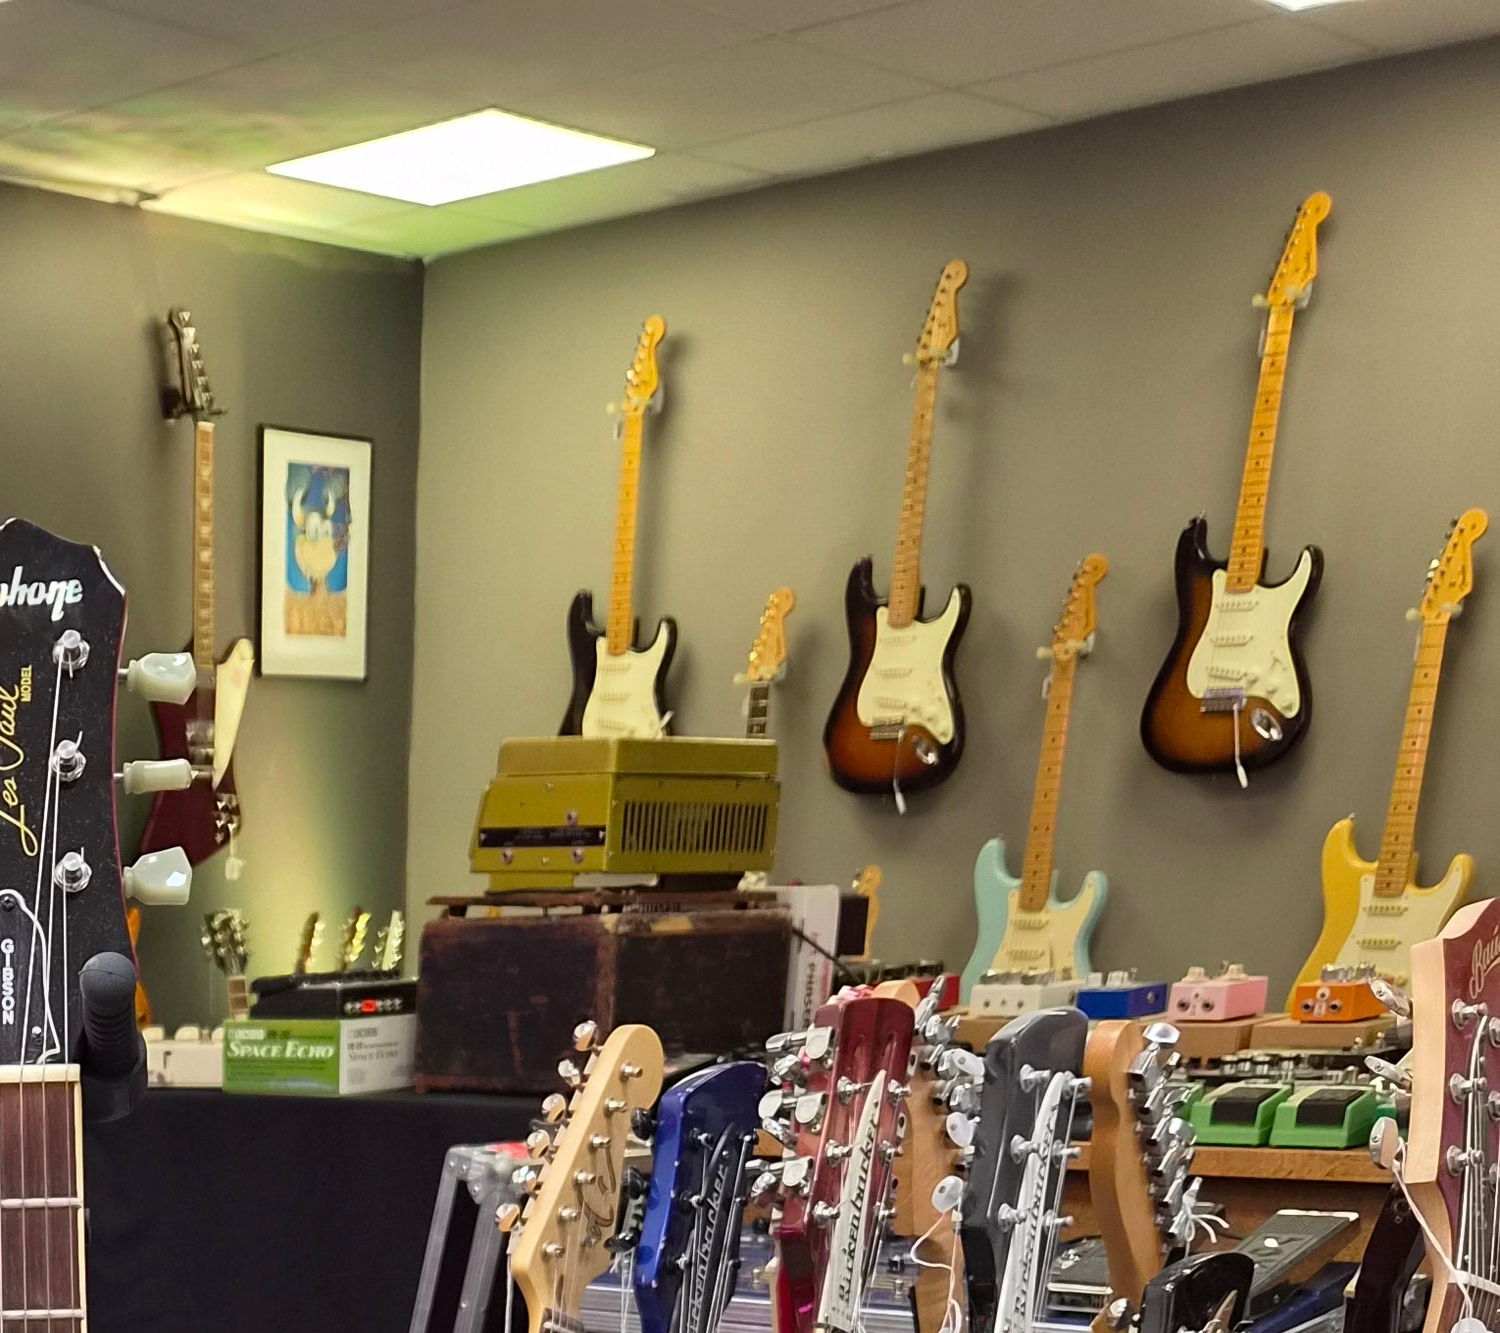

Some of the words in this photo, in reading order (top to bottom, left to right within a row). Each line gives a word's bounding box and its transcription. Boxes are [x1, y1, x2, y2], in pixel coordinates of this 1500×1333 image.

[20, 664, 33, 703] MODEL
[0, 938, 15, 1025] GIBSON
[227, 1040, 282, 1059] SPACE
[284, 1040, 335, 1059] ECHO
[836, 1116, 877, 1302] Rickenbacker
